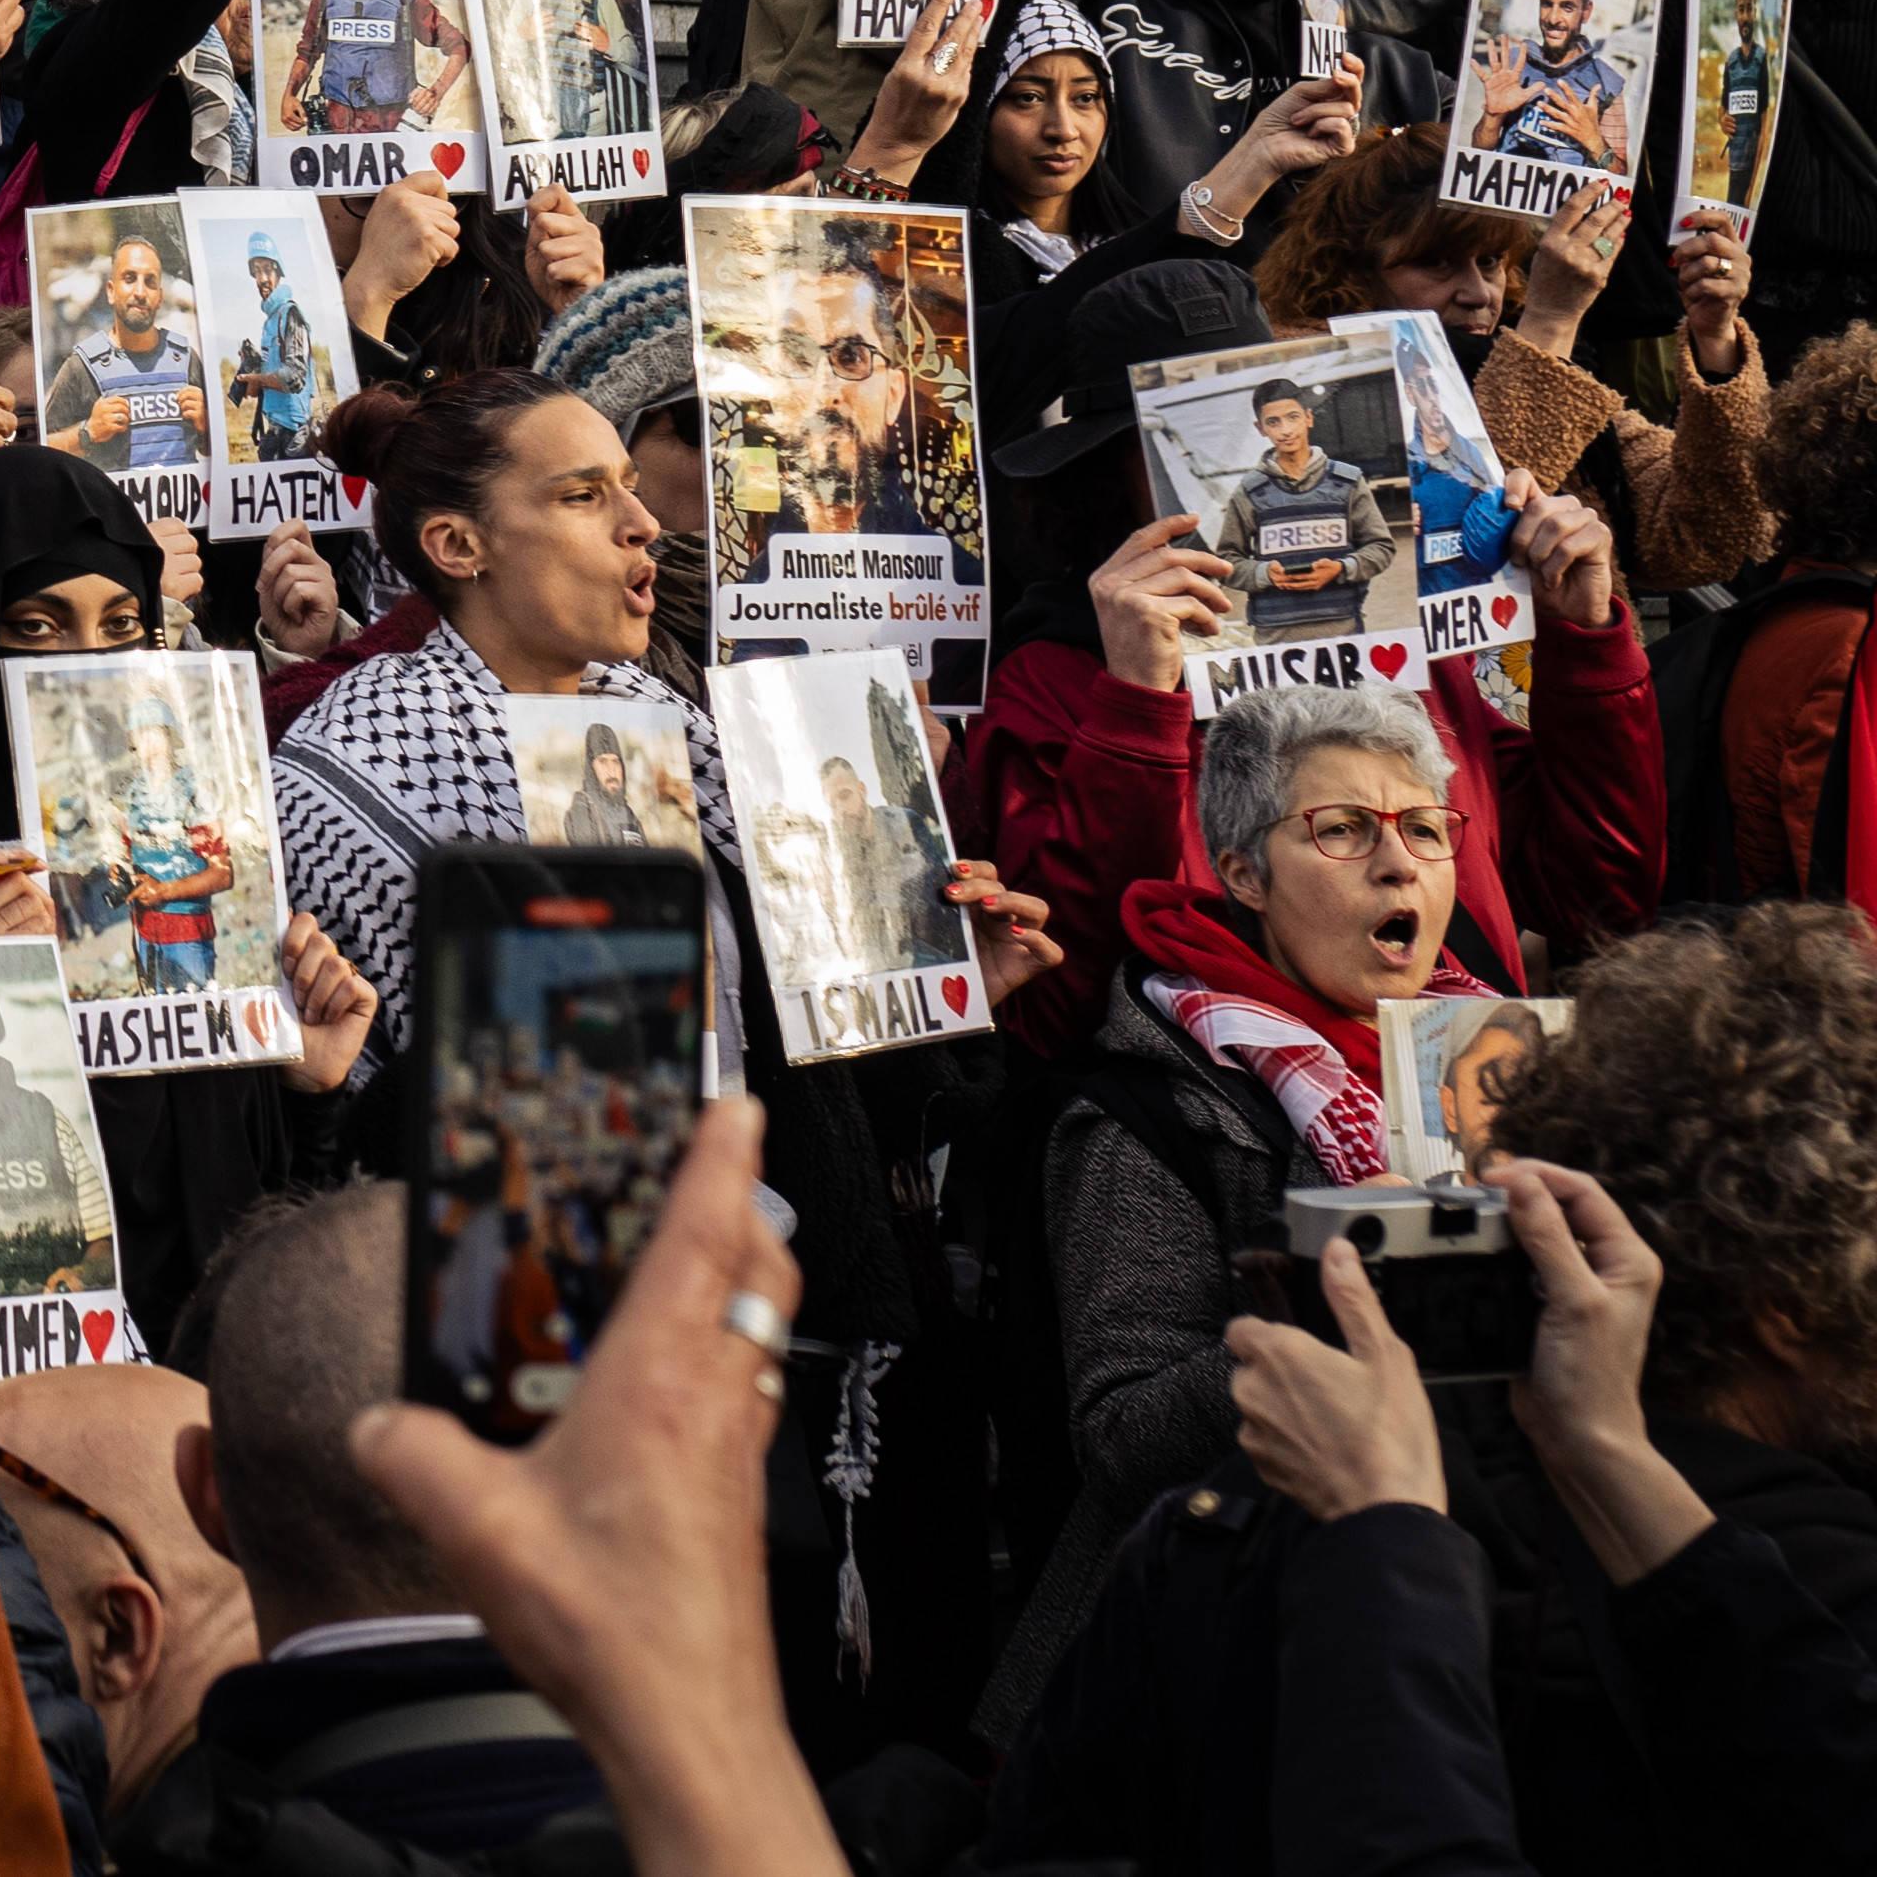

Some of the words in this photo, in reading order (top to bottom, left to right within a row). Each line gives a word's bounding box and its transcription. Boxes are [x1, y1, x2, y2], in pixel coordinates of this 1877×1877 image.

[331, 19, 394, 42] PRESS
[1731, 92, 1757, 111] PRESS
[290, 142, 410, 190] OMAR
[231, 470, 341, 524] HATEM
[1264, 523, 1343, 551] PRESS
[783, 549, 857, 580] Ahmed
[863, 549, 944, 581] Mansour
[729, 592, 883, 622] Journaliste
[890, 592, 947, 621] brûlé
[952, 592, 981, 620] vif
[800, 972, 942, 1051] ISMAIL
